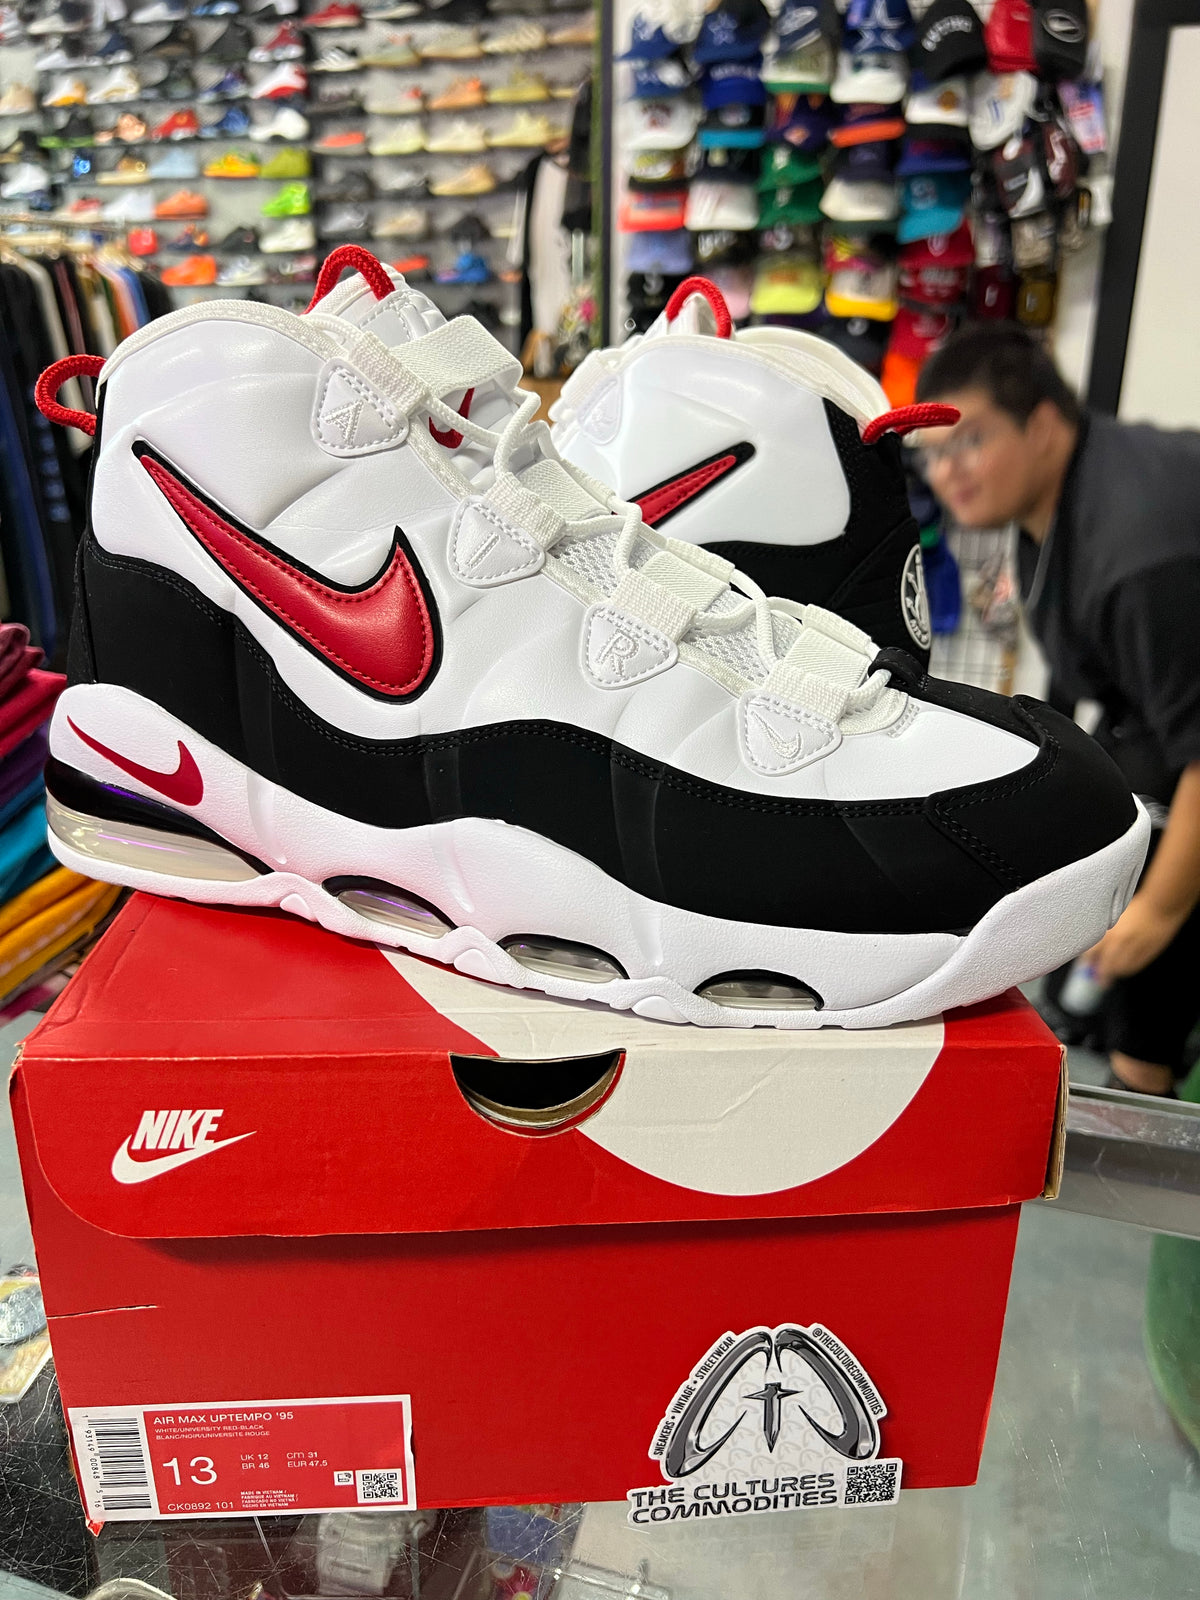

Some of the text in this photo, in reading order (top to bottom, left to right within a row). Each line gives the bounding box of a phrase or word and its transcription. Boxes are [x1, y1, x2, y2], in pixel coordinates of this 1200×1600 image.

[596, 628, 640, 677] R
[131, 1109, 224, 1149] NIKE
[812, 1327, 883, 1415] @THECULTURECOMMODITIES
[653, 1336, 736, 1456] SNEAKERS VINTAGE STREETWEAR
[153, 1411, 294, 1425] AIR MAX UPTEMPO '95
[155, 1425, 221, 1434] WHITE/UNIVERSITY
[85, 1429, 95, 1452] 93149
[162, 1456, 218, 1486] 13
[167, 1501, 234, 1511] CK0892 101
[631, 1472, 836, 1508] THE CULTURES
[632, 1489, 838, 1524] COMMODITIES
